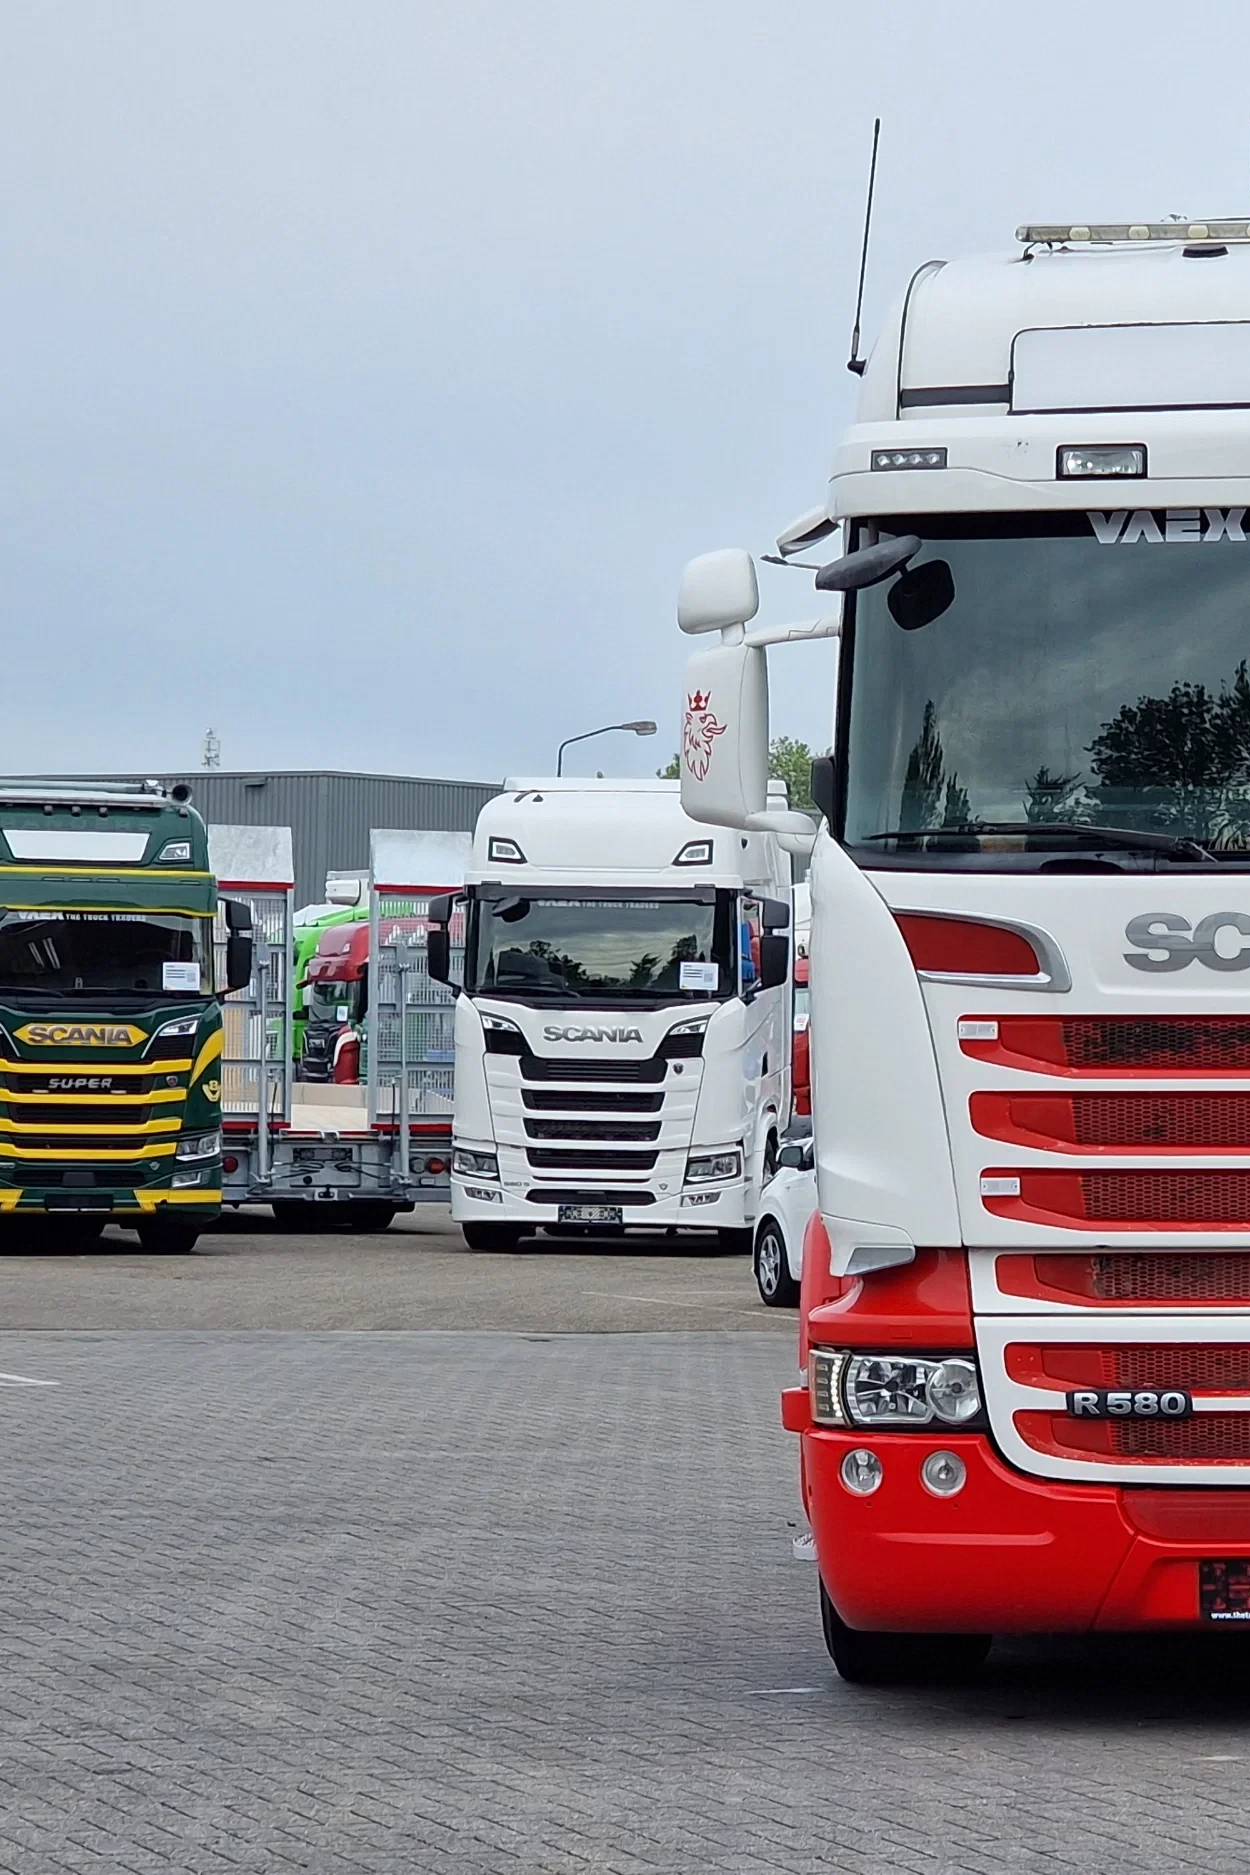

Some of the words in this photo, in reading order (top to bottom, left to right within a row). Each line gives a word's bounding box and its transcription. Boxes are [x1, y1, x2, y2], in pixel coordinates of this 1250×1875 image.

[1086, 509, 1248, 545] VAEX
[27, 1024, 133, 1045] SCANIA
[543, 1025, 644, 1043] SCANIA
[48, 1077, 113, 1089] SUPER
